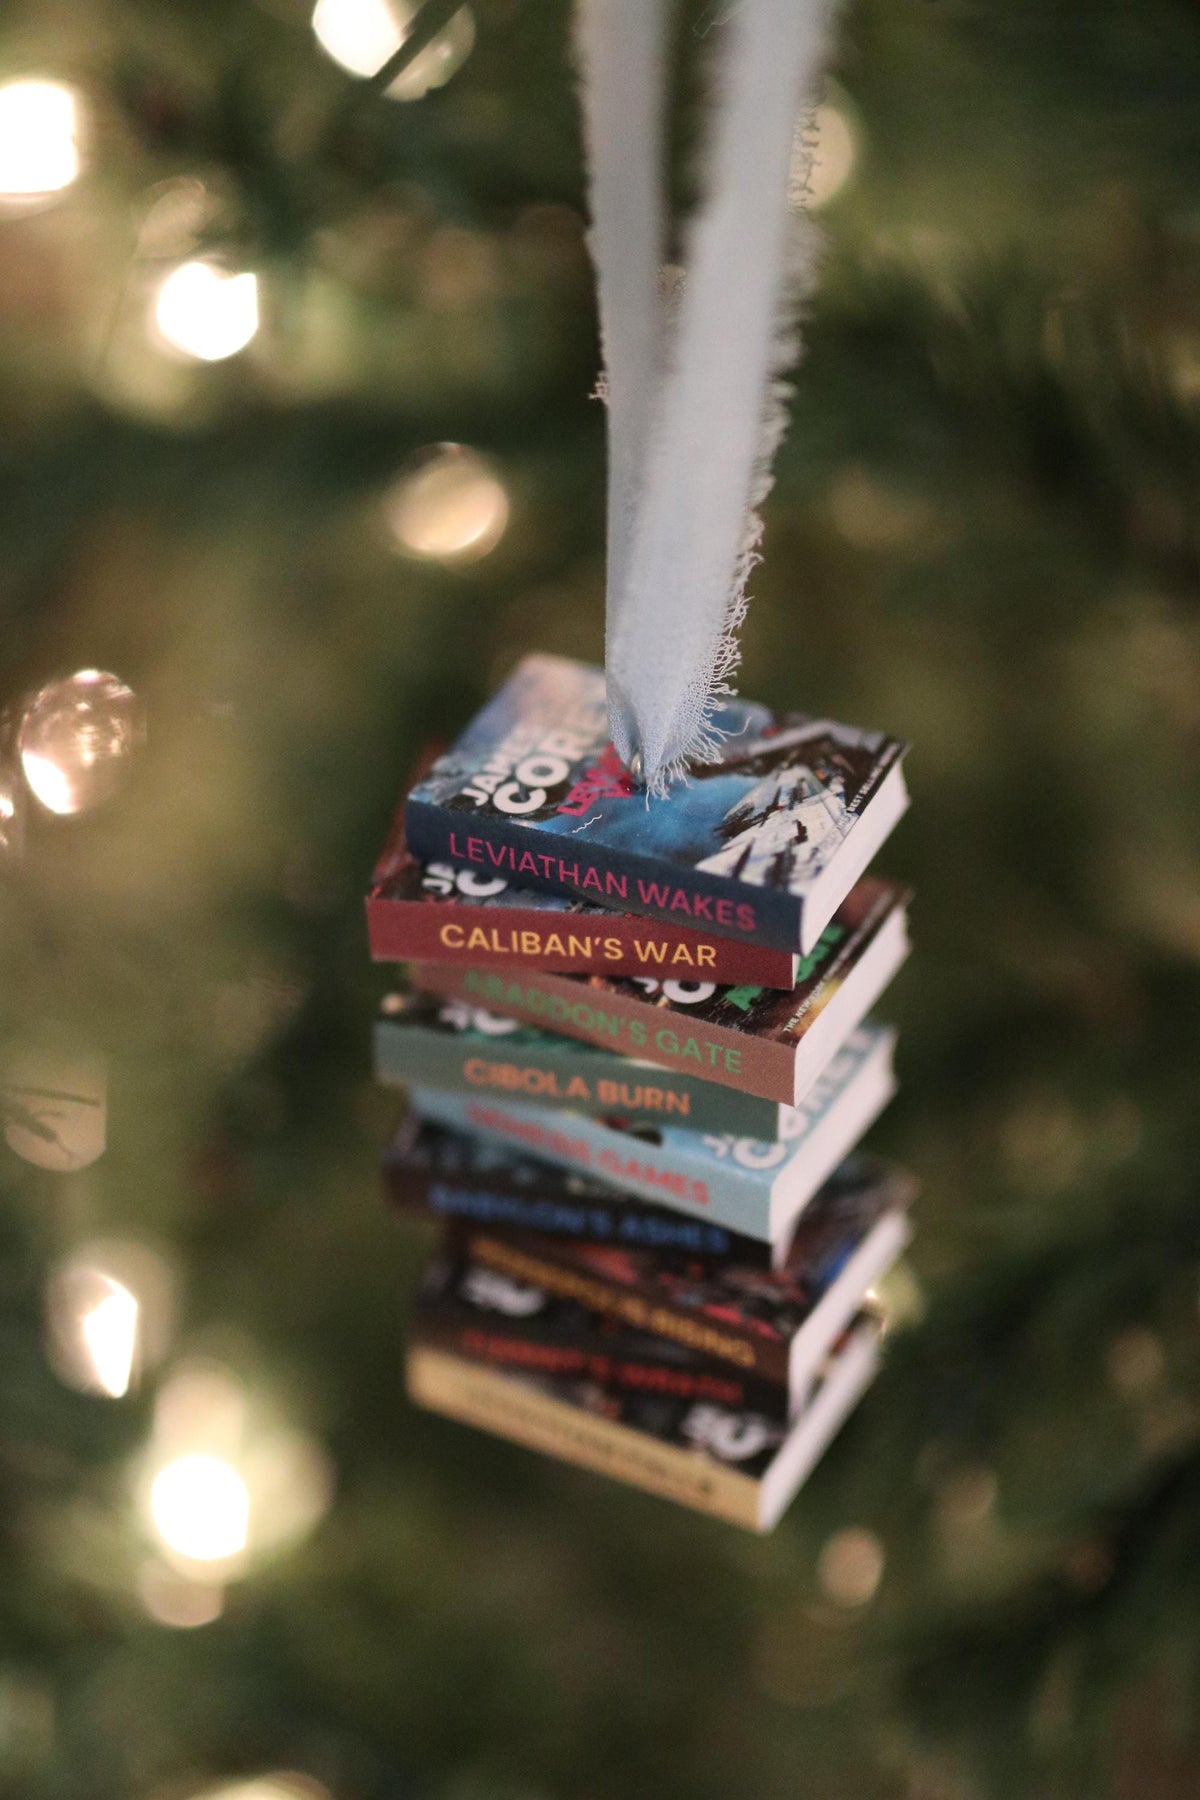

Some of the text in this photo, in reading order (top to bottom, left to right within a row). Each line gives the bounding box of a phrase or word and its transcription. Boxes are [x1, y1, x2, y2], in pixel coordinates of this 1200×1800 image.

[449, 831, 627, 898] LEVIATHAN
[637, 880, 755, 930] WAKES
[440, 924, 716, 967] CALIBAN'S WAR
[655, 1028, 742, 1075] GATE
[463, 1058, 690, 1115] CIBOLA BURN
